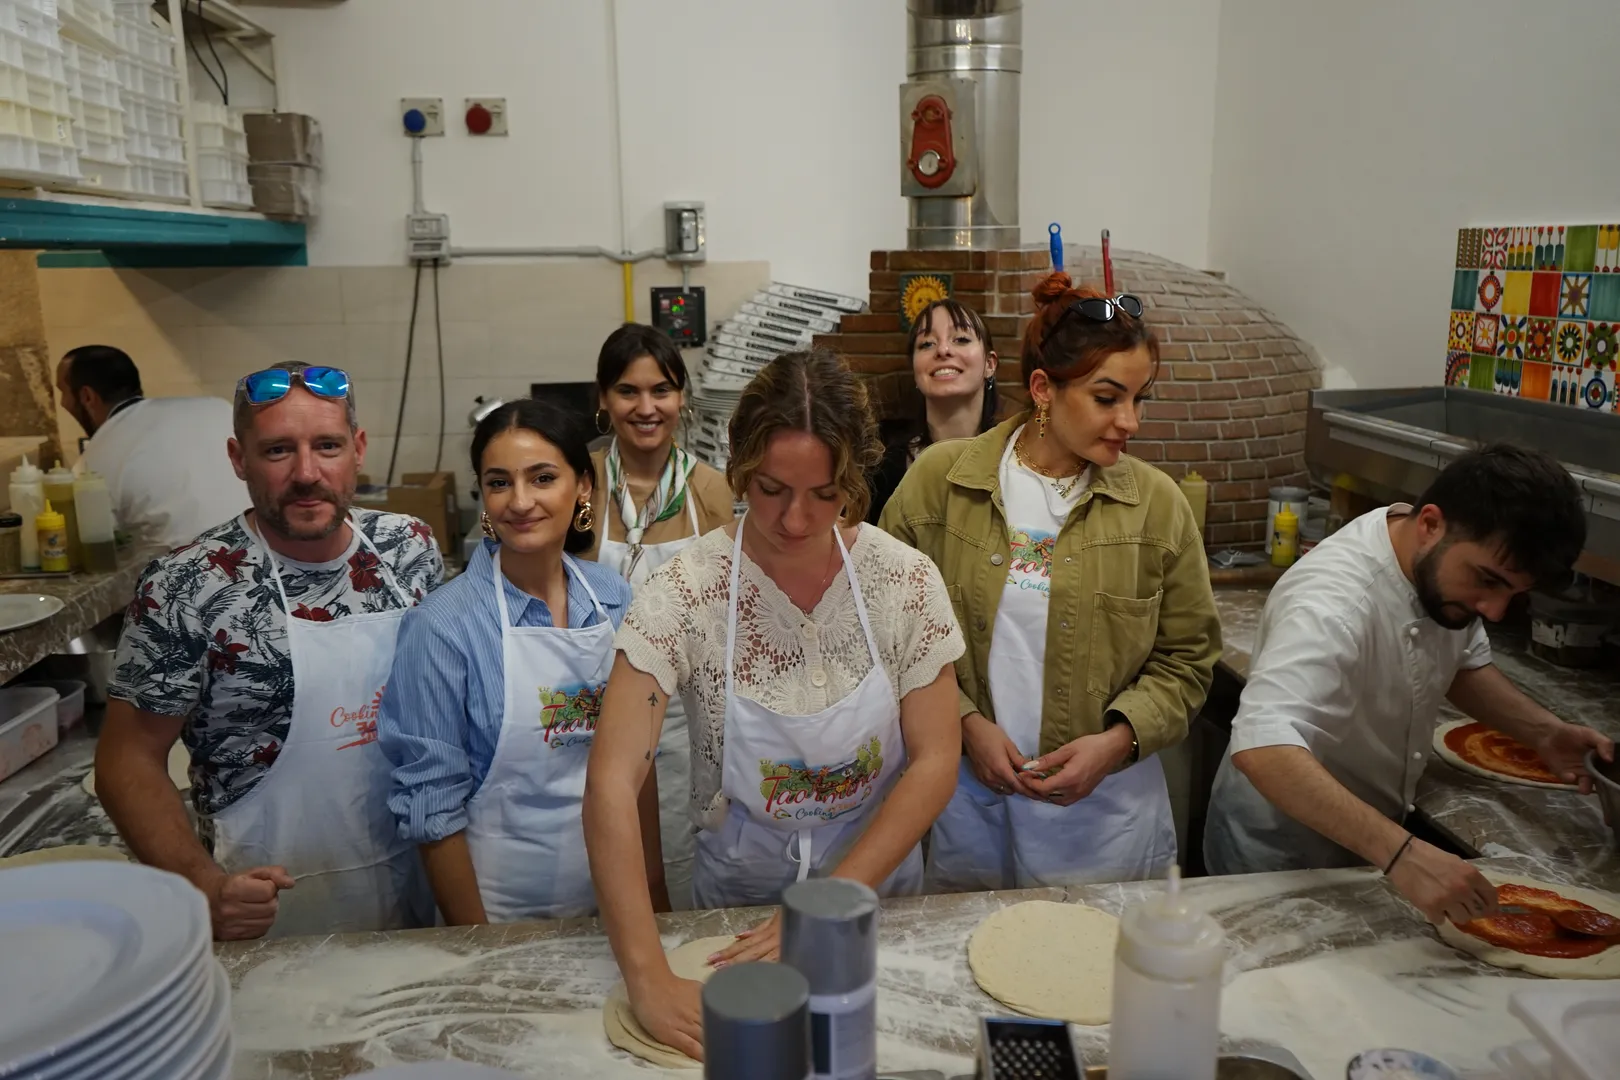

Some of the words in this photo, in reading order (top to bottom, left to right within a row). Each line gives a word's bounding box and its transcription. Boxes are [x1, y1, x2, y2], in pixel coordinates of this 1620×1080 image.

[1020, 578, 1050, 592] Cookin
[330, 704, 378, 728] Cookin
[763, 767, 880, 813] Taormina
